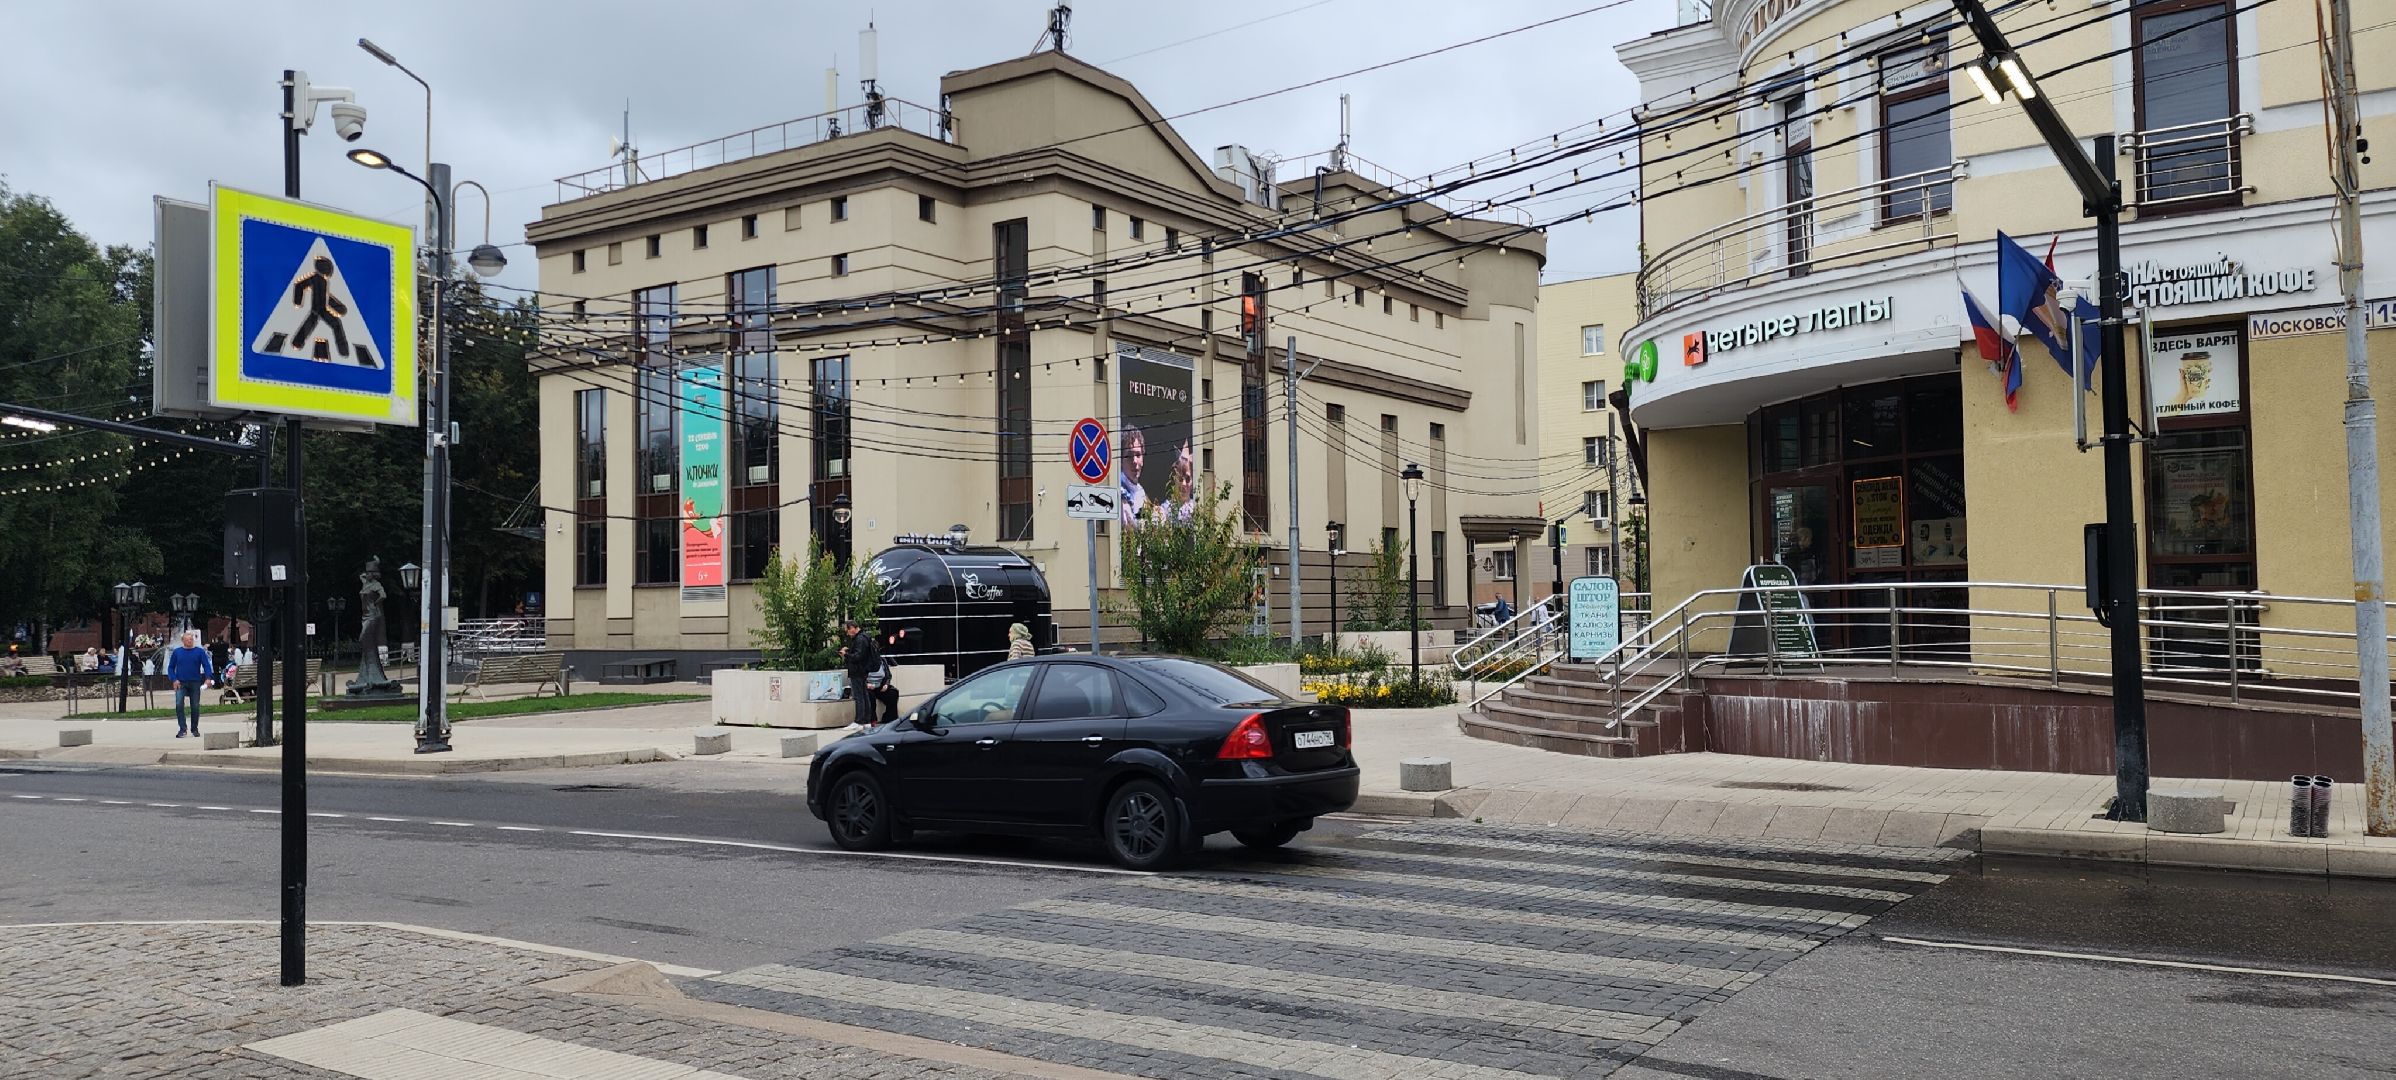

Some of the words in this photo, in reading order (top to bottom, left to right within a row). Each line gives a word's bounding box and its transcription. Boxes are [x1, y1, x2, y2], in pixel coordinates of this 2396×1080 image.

[2132, 273, 2244, 309] СТОЯЩИЙ
[2247, 268, 2317, 298] КОФЕ
[1806, 297, 1892, 333] лапы
[2197, 335, 2238, 348] ВАРЯТ
[1129, 380, 1177, 400] РЕПЕРТУАР
[686, 464, 718, 480] КЛОЧКИ
[698, 571, 708, 581] 6+
[978, 584, 1004, 600] Coffee
[1574, 582, 1614, 591] САЛОН
[1577, 593, 1610, 602] ШТОР
